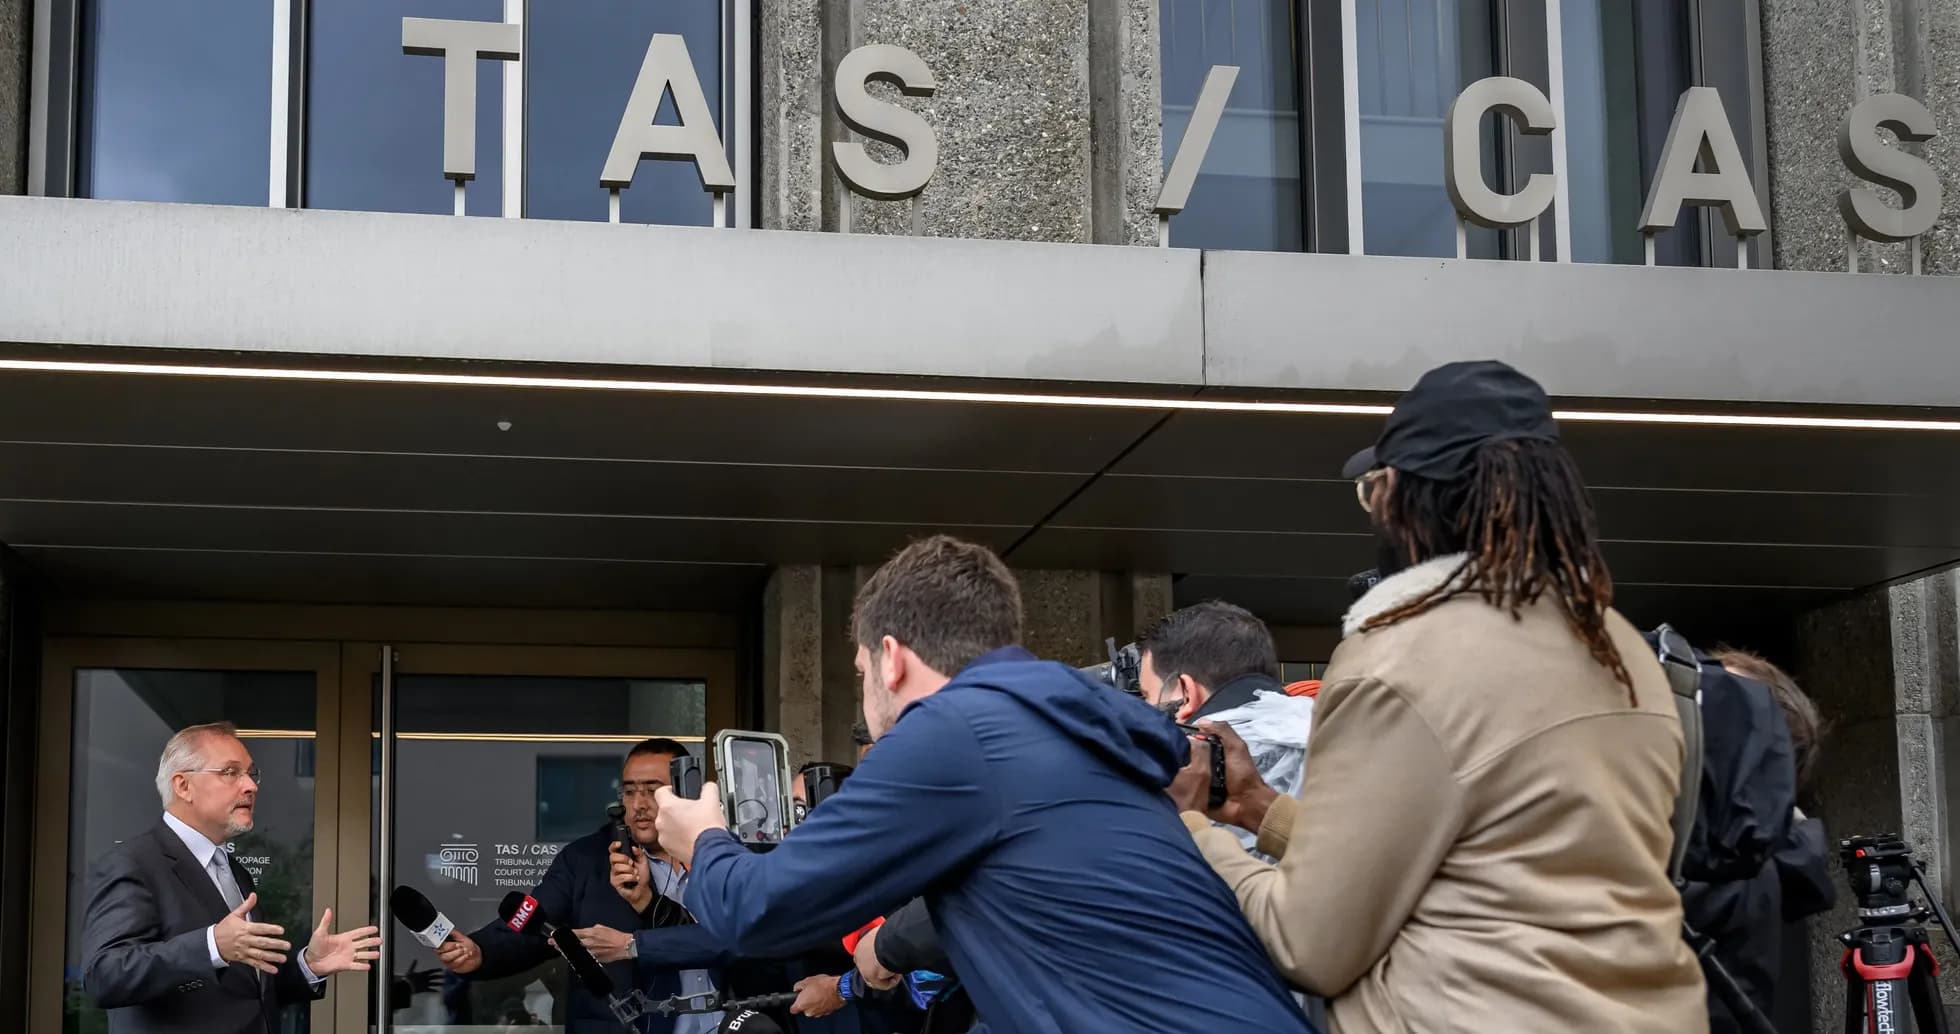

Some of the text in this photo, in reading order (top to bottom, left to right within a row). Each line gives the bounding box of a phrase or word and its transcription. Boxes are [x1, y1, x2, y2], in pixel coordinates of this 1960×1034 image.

[402, 16, 1943, 244] TAS / CAS
[494, 844, 558, 855] TAS / CAS
[494, 868, 523, 876] COURT
[524, 868, 536, 876] OF
[495, 879, 536, 887] TRIBUNAL
[511, 901, 533, 929] RMC
